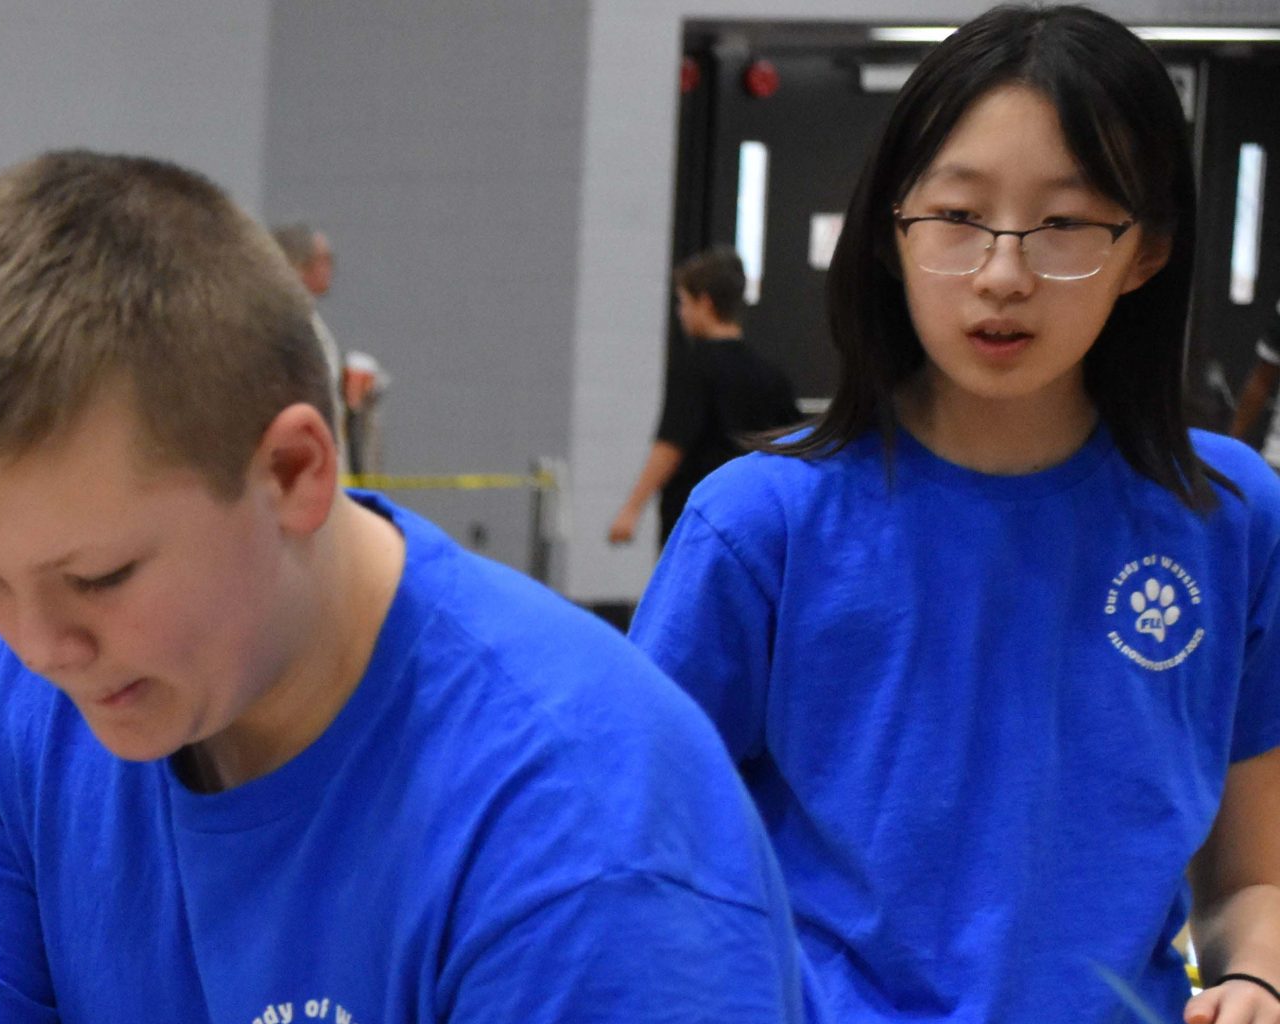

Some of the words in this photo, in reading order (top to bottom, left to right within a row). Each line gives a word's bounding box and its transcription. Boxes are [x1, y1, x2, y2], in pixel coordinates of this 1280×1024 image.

[1112, 560, 1139, 586] Lady
[1143, 554, 1156, 567] of
[1161, 555, 1201, 605] Wayside
[1140, 618, 1162, 630] FLL
[304, 998, 330, 1019] of
